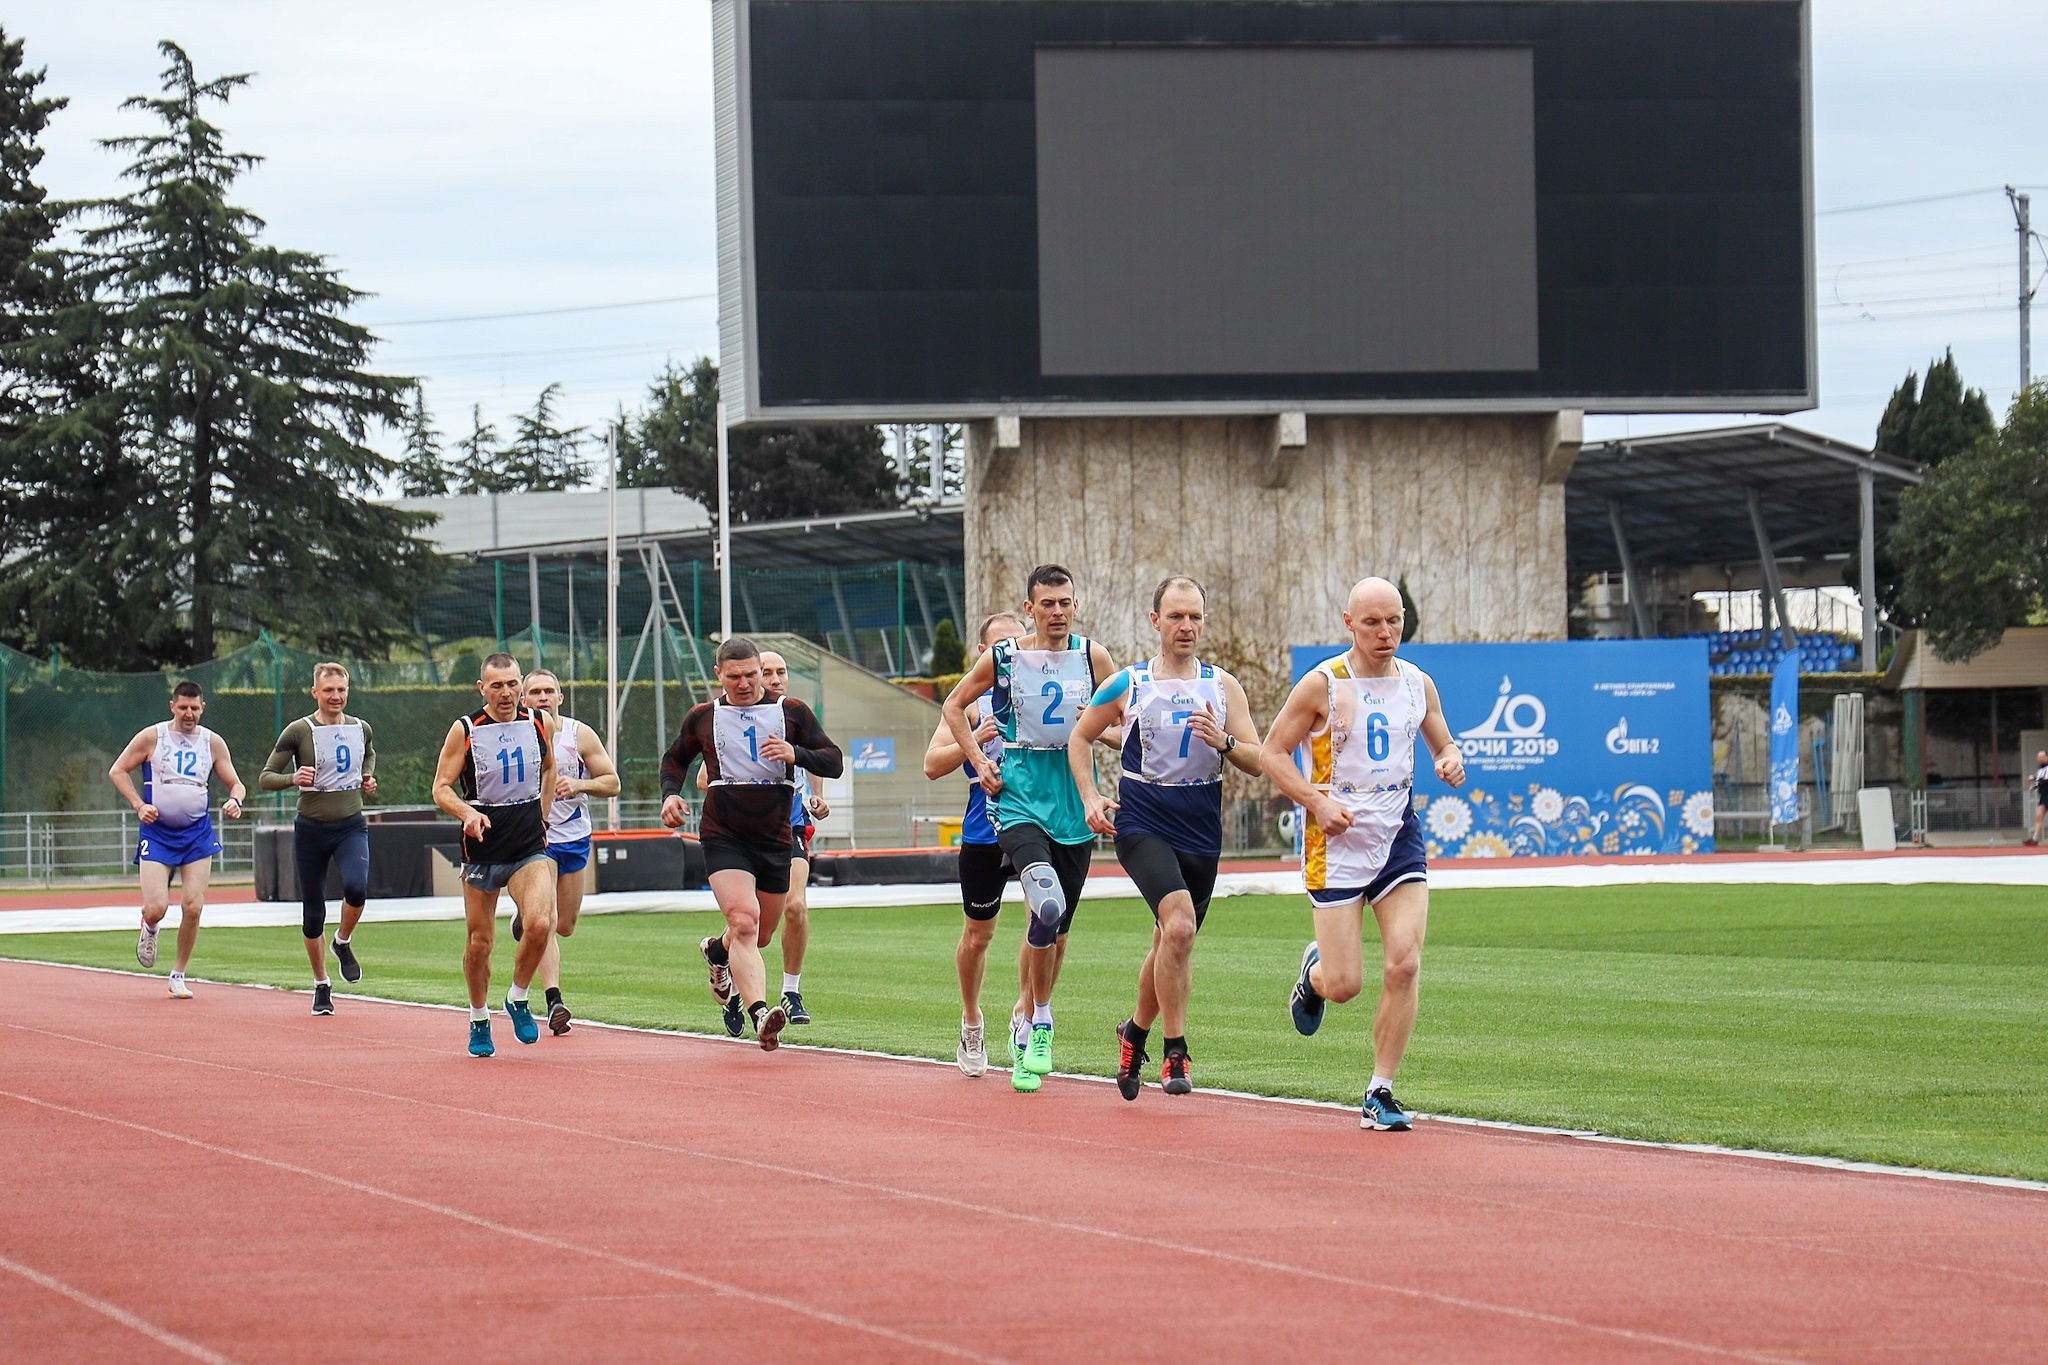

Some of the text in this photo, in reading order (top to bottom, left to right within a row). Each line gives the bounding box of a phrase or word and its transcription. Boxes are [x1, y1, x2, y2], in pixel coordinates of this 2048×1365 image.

[1041, 681, 1064, 724] 2
[743, 726, 758, 761] 1
[1172, 711, 1194, 758] 7
[1367, 712, 1389, 761] 6
[1512, 738, 1560, 756] 2019
[174, 750, 197, 777] 12
[336, 745, 351, 773] 9
[496, 746, 525, 784] 11
[140, 839, 150, 856] 2
